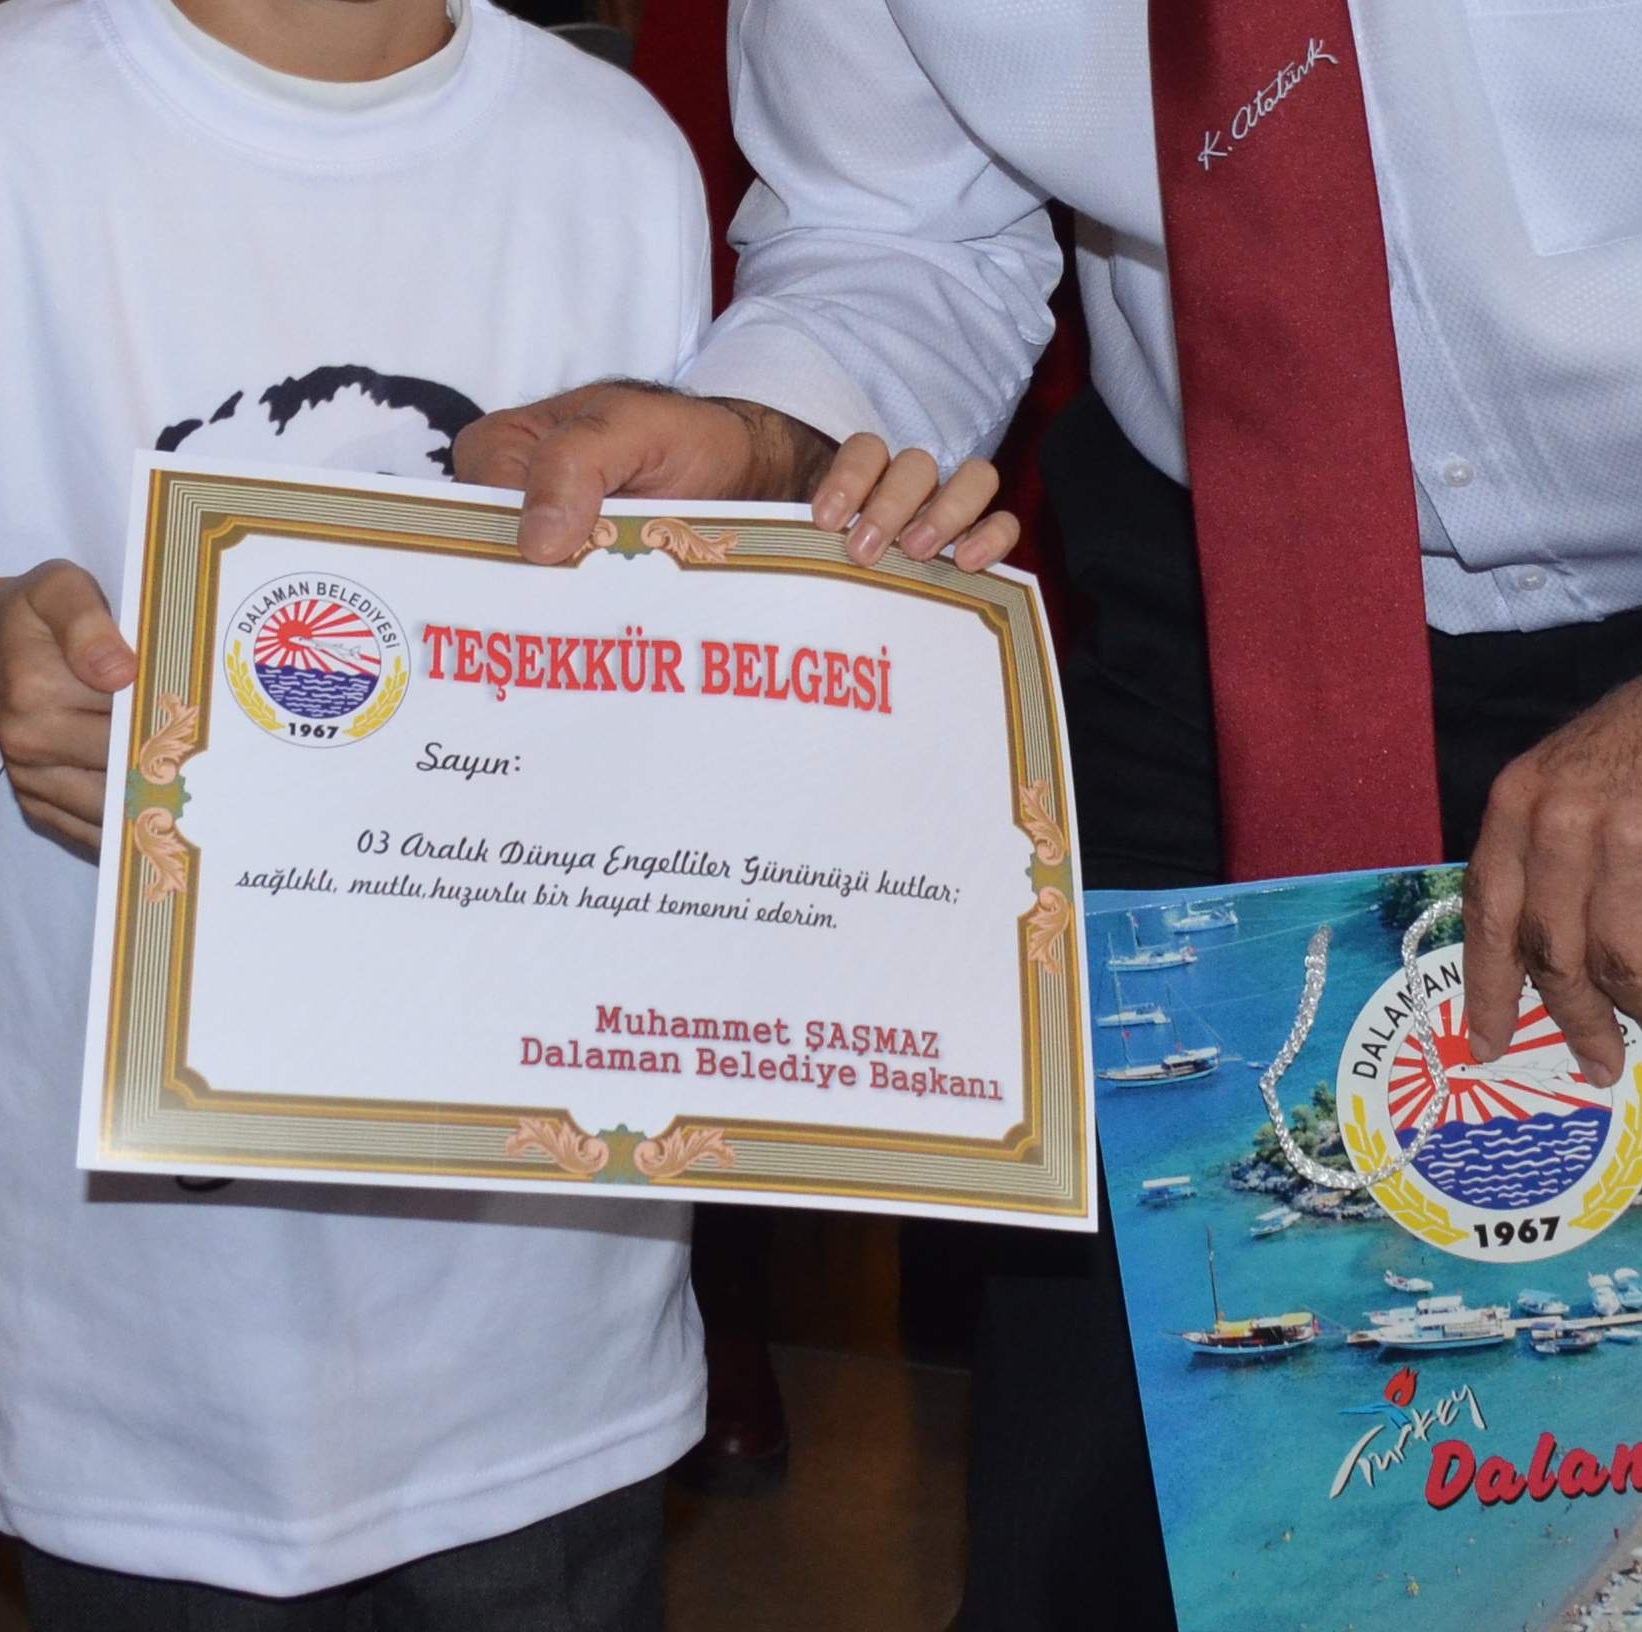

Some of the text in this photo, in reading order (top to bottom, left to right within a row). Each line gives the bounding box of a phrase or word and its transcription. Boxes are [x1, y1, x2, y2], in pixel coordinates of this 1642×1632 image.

[237, 581, 401, 649] DALAMAN BELEDİYESİ
[422, 624, 892, 714] TEŞEKKÜR BELGESİ
[288, 722, 340, 739] 1967
[416, 742, 521, 780] Sayın:
[356, 829, 390, 854] 03
[399, 832, 488, 863] Aralık
[498, 840, 597, 874] Dünya
[602, 845, 732, 879] Engelliler
[740, 856, 870, 897] Gününüzü
[532, 884, 568, 908] bir
[575, 886, 653, 917] hayat
[656, 893, 751, 922] temenni
[595, 1004, 940, 1060] Muhammet ŞAŞMAZ
[520, 1036, 1004, 1102] Dalaman Belediye Başkanı
[1474, 1216, 1561, 1248] 1967
